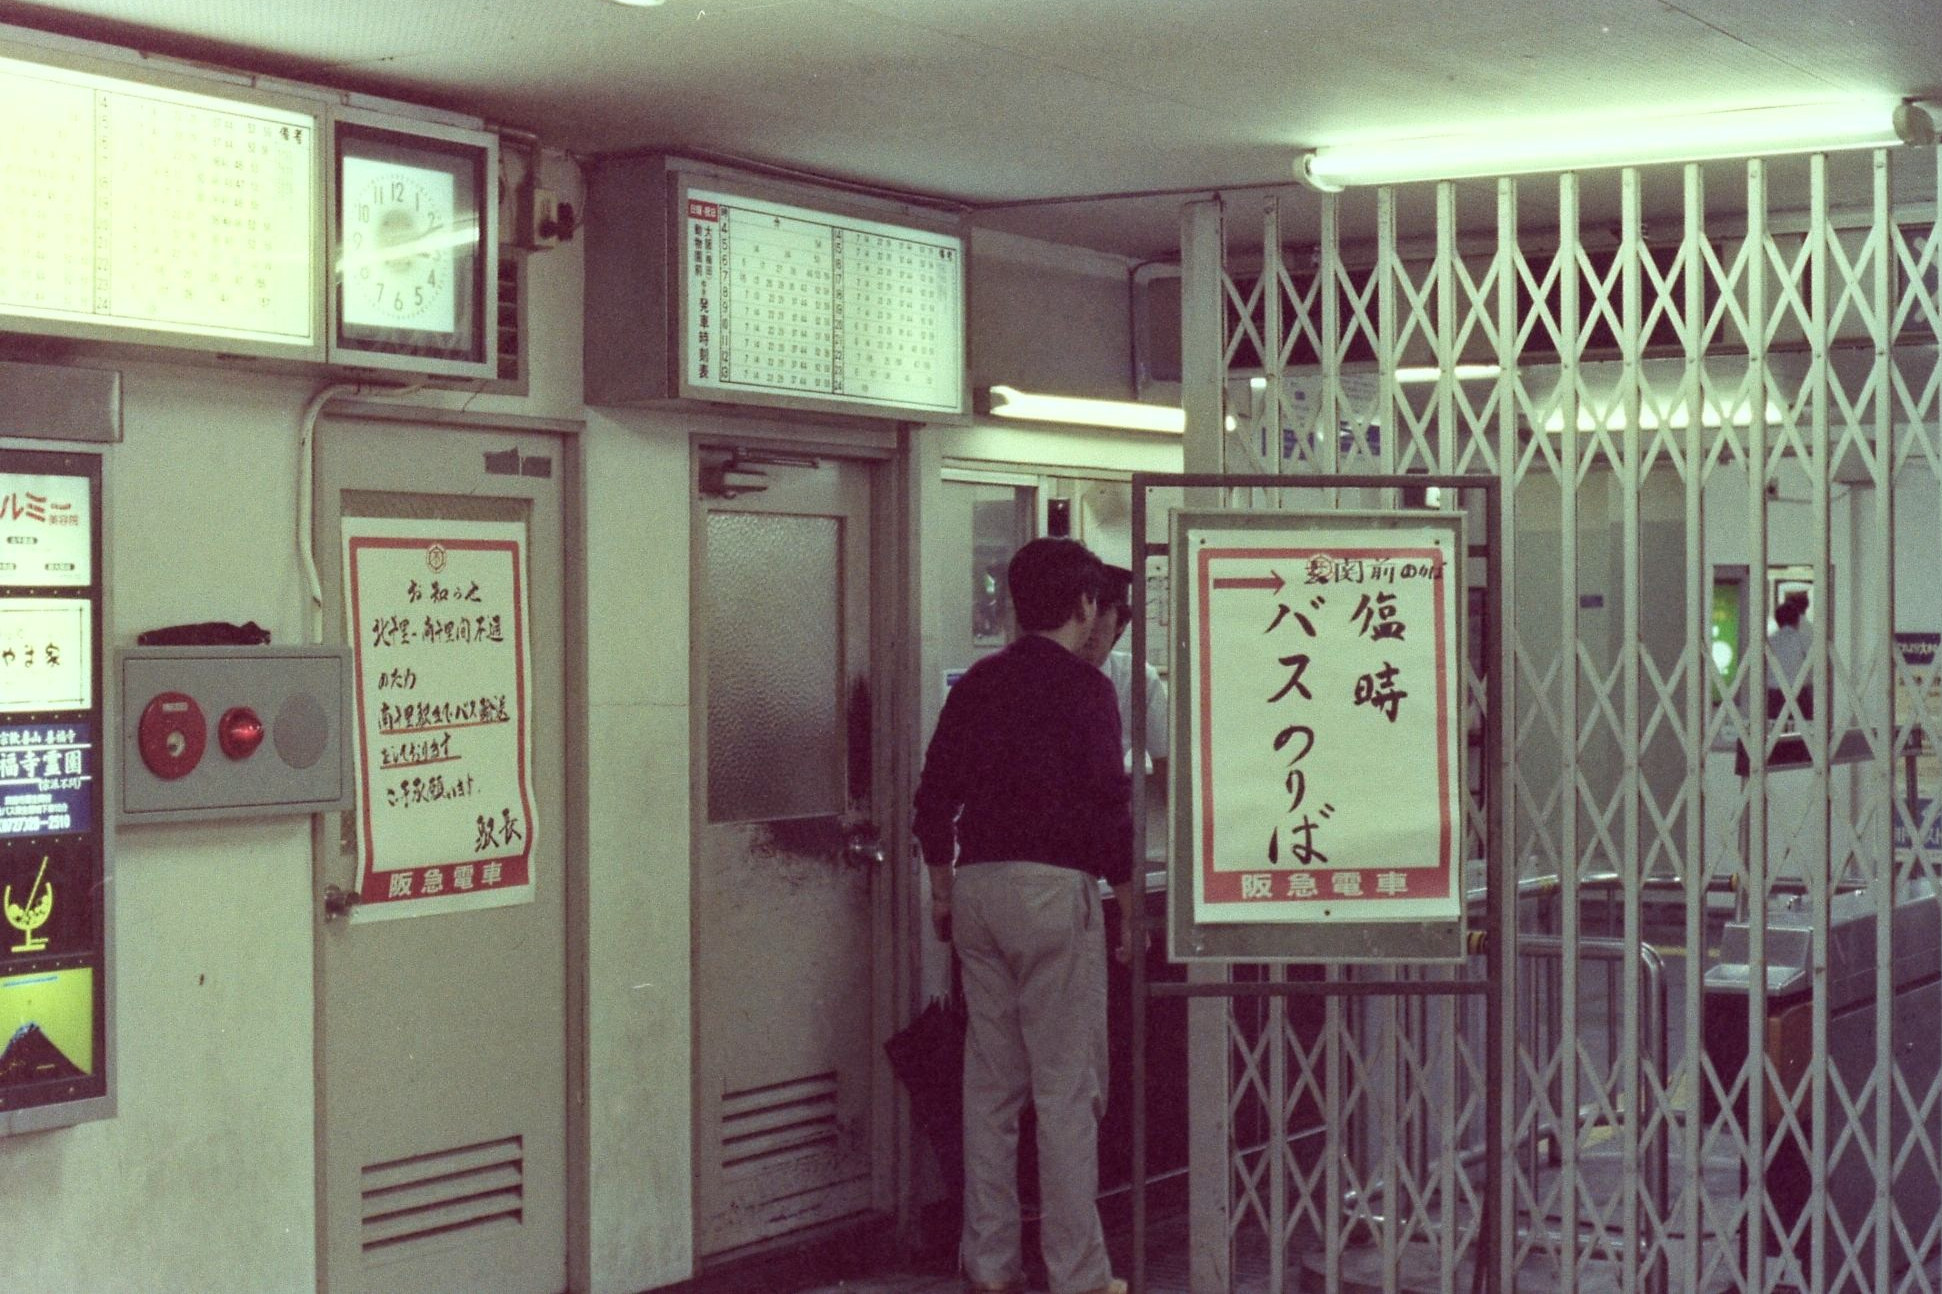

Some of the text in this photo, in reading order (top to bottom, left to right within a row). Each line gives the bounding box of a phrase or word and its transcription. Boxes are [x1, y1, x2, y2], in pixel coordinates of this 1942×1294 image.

[374, 185, 384, 205] 11
[391, 182, 405, 203] 12
[415, 192, 420, 212] 1
[357, 204, 369, 224] 10
[721, 223, 728, 233] 4
[353, 232, 363, 250] 9
[721, 238, 728, 250] 5
[721, 255, 728, 266] 6
[427, 268, 437, 289] 4
[722, 271, 728, 281] 7
[376, 282, 385, 303] 7
[393, 291, 404, 312] 6
[414, 286, 424, 307] 5
[722, 286, 728, 297] 8
[722, 301, 728, 313] 9
[407, 579, 482, 604] お知らせ
[1349, 592, 1409, 724] 臨時
[1263, 594, 1336, 866] バスのりば
[474, 807, 523, 853] 駅長
[388, 861, 503, 898] 阪急電車
[1241, 872, 1409, 900] 阪急電車
